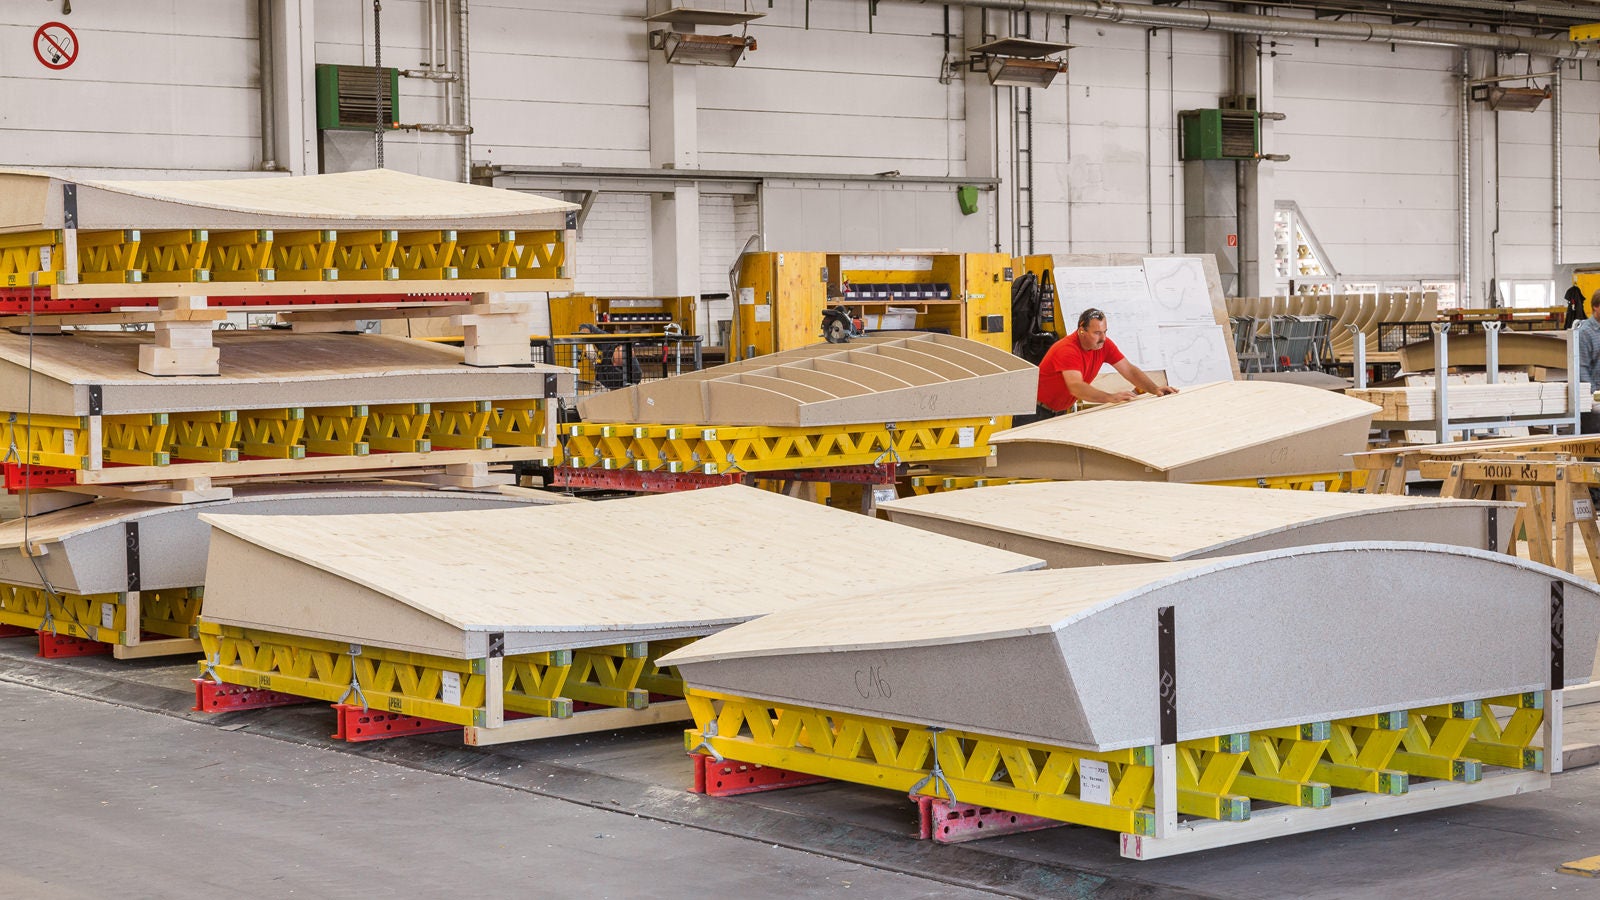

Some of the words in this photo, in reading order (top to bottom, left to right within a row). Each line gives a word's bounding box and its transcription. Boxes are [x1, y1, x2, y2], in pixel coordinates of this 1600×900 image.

[1560, 444, 1586, 454] 1000
[1483, 465, 1512, 478] 1000
[1521, 465, 1538, 481] Kg
[854, 666, 892, 699] C16
